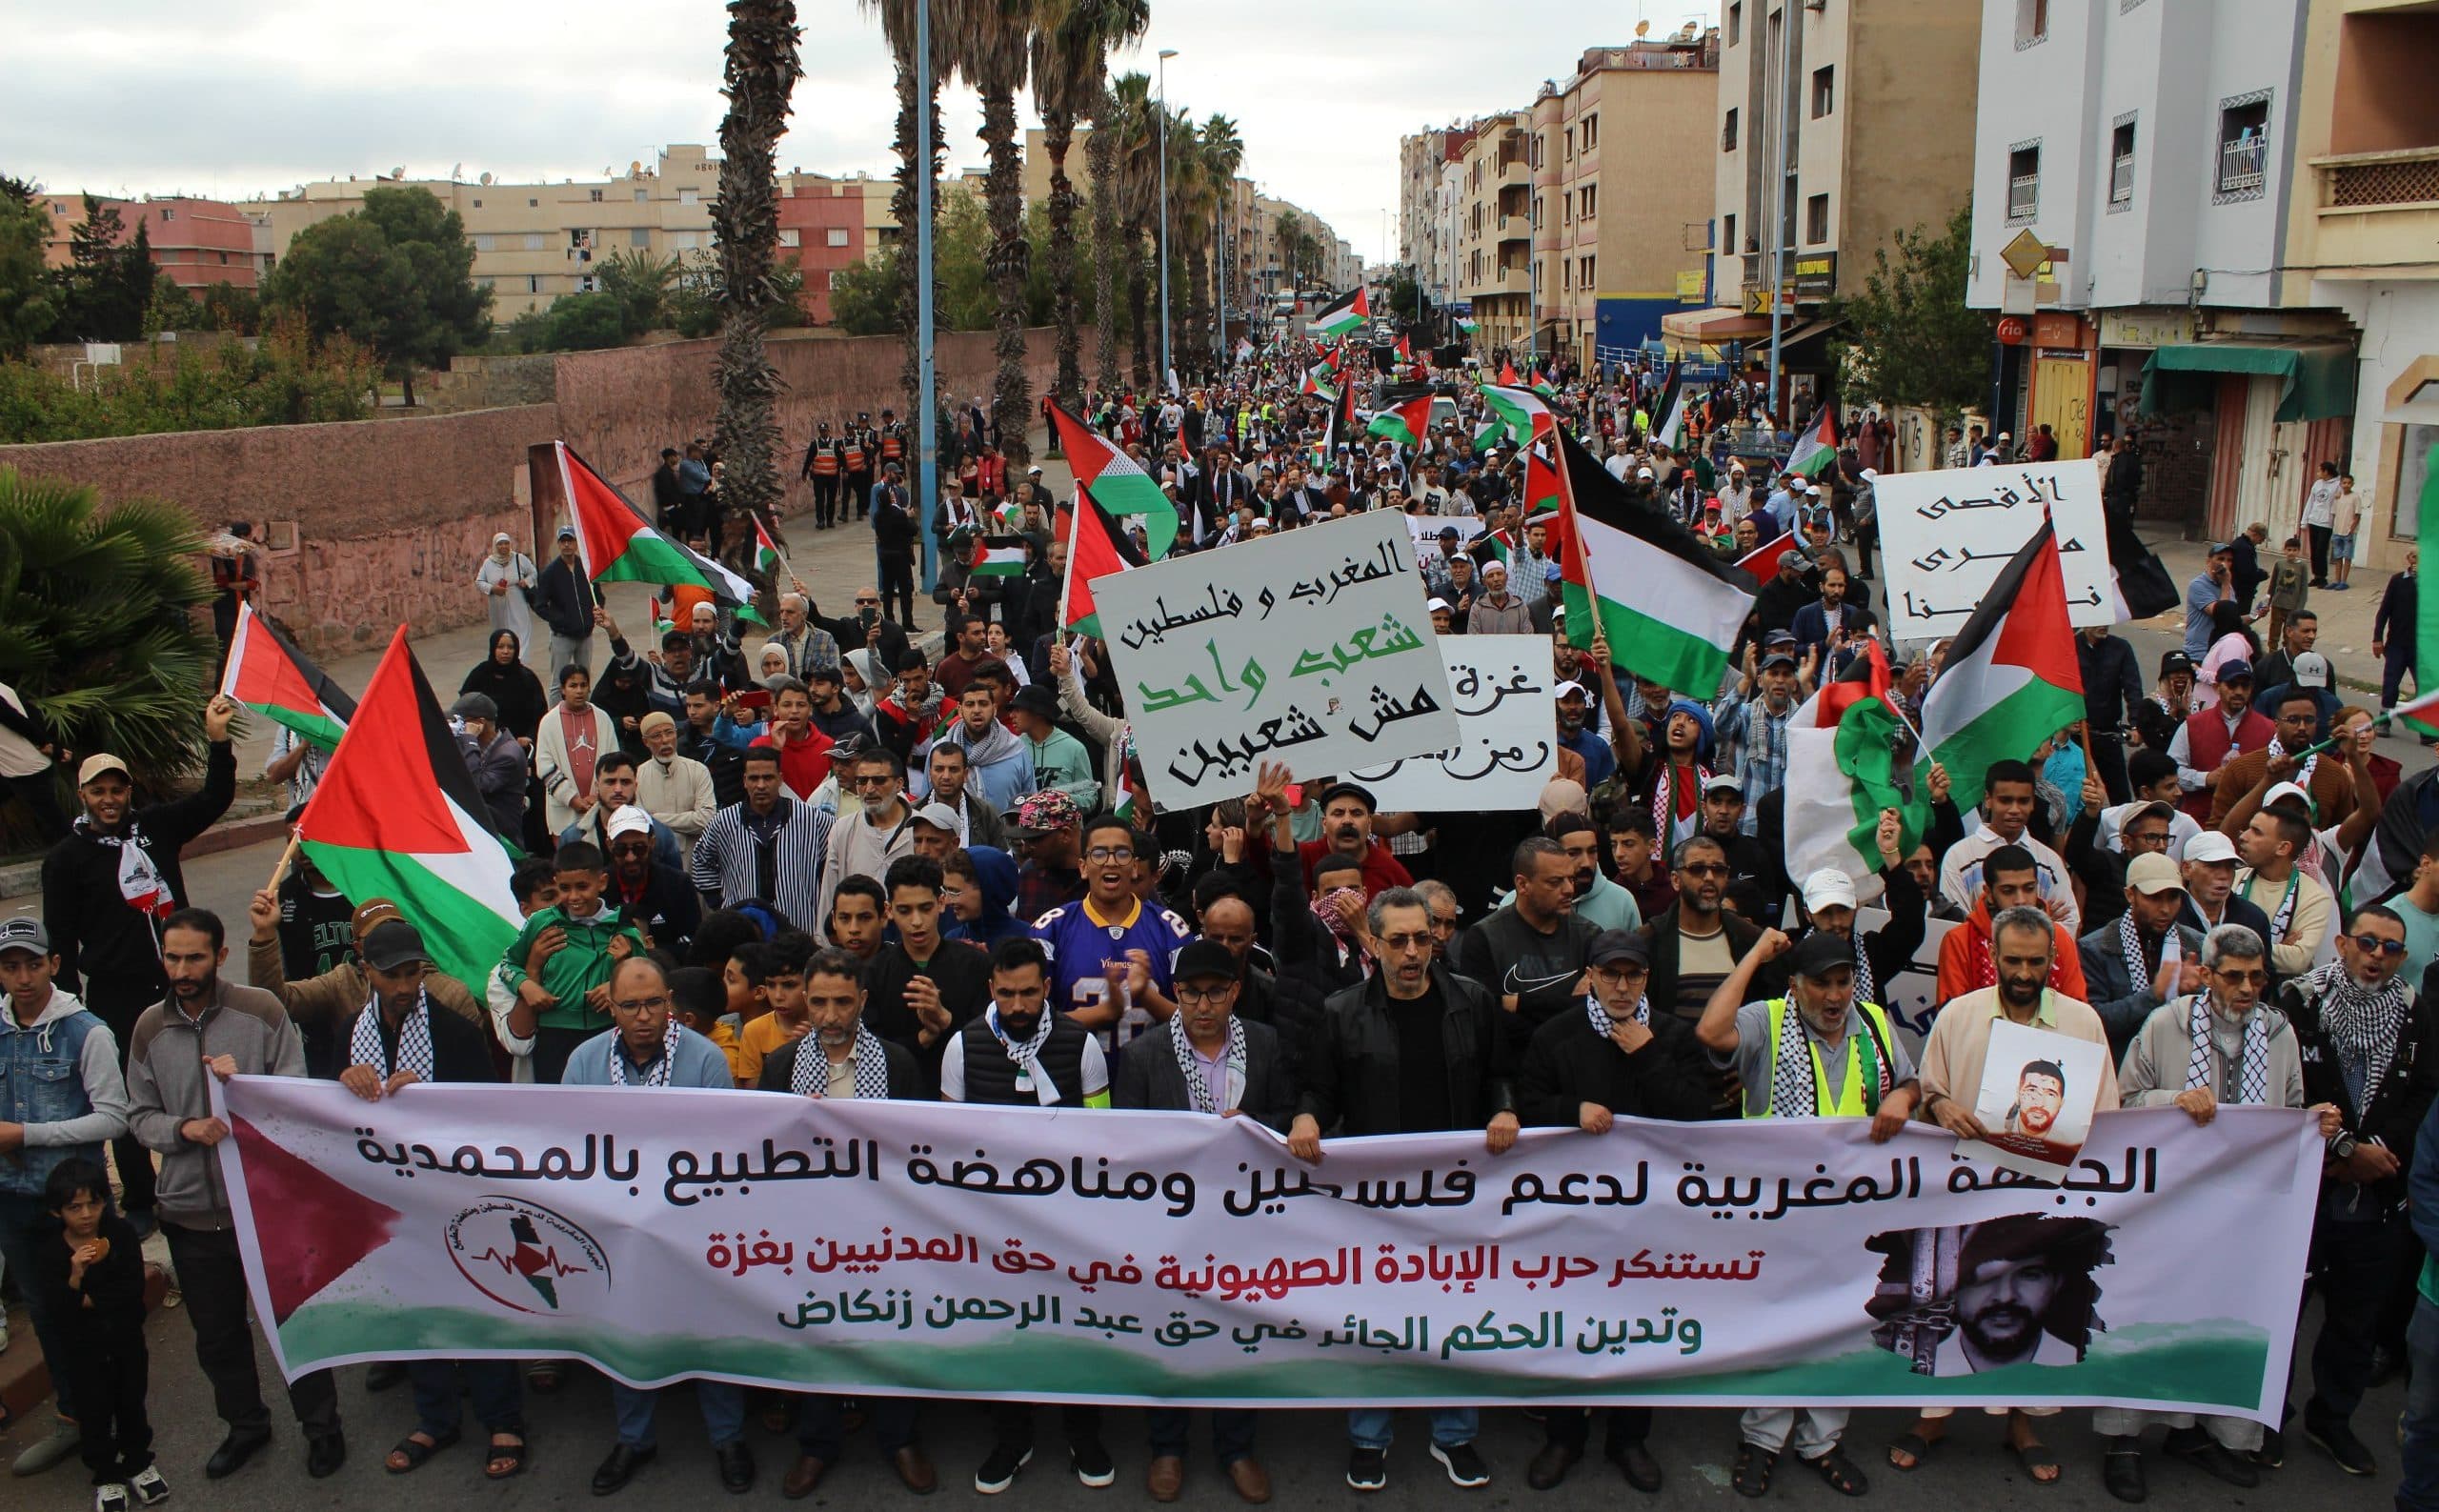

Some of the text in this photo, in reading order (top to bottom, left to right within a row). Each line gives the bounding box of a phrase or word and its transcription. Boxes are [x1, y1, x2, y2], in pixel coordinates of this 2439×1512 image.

[2002, 322, 2022, 336] ria
[1916, 472, 2068, 519] الأقصى
[1120, 538, 1407, 651] المغرب و فلسطين
[1138, 612, 1425, 714] شعب واحد
[1452, 665, 1542, 716] غزة
[1168, 705, 1328, 788] شعبين
[1349, 683, 1441, 742] مش
[1441, 738, 1548, 781] رمز
[355, 1127, 639, 1197] بالمحمدية
[664, 1136, 879, 1206] التطبيع
[907, 1144, 1196, 1217] ومناهضة
[1502, 1159, 1649, 1216] لدعم
[1676, 1157, 1920, 1220] المغربية
[706, 1226, 1765, 1302] تستنكر حرب الإبادة الصهيونية في حق المدنيين بغزة
[777, 1288, 1702, 1361] وتدين الحكم الجائر في حق عبد الرحمن زنكاض
